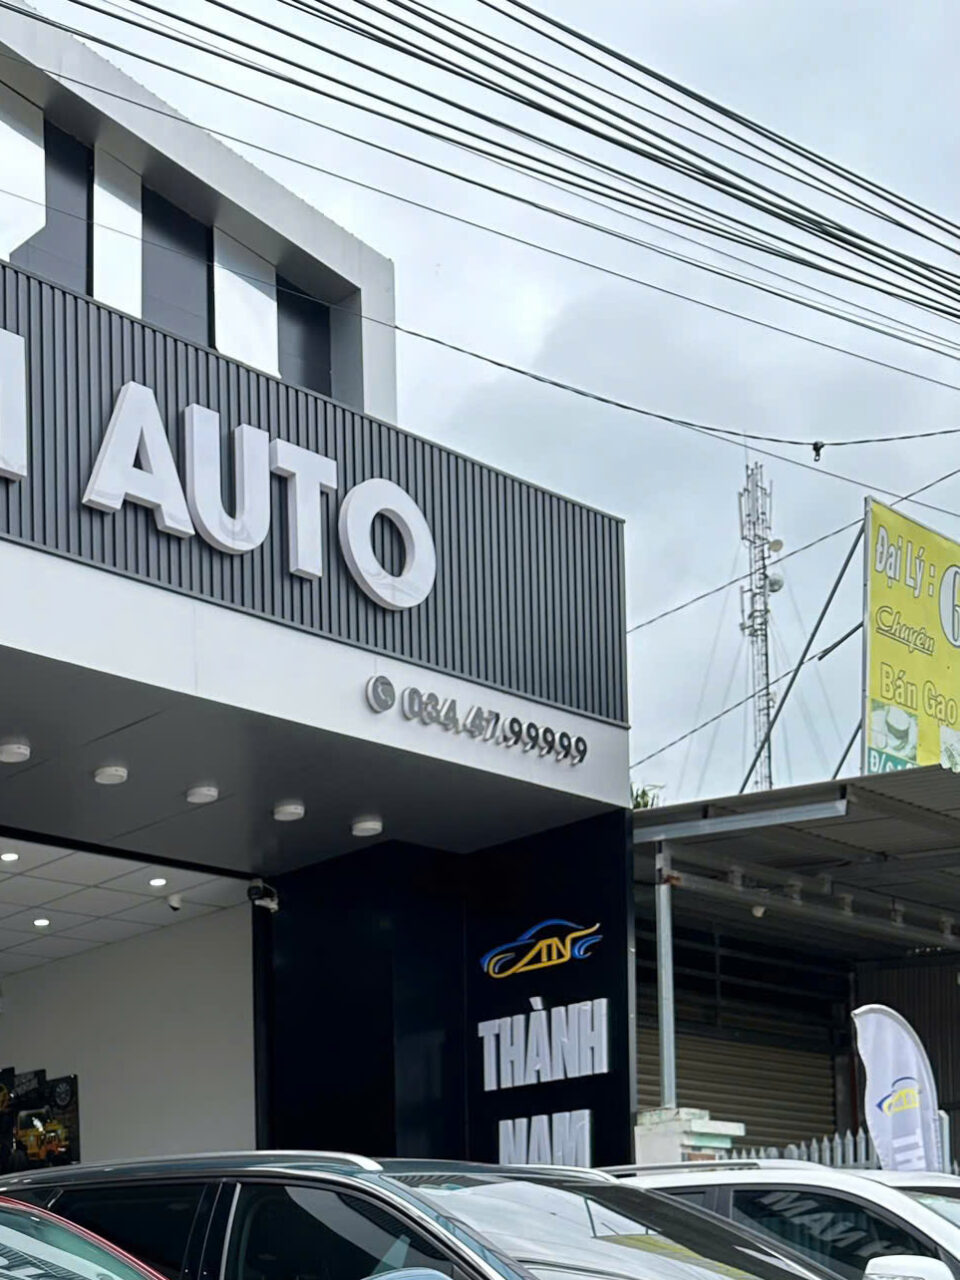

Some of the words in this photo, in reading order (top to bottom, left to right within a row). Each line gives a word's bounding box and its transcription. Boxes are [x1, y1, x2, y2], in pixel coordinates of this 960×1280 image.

[81, 380, 437, 612] AUTO
[881, 662, 919, 711] Bán
[922, 680, 958, 728] Gạo
[478, 996, 609, 1091] THÀNH
[498, 1108, 591, 1168] NAM
